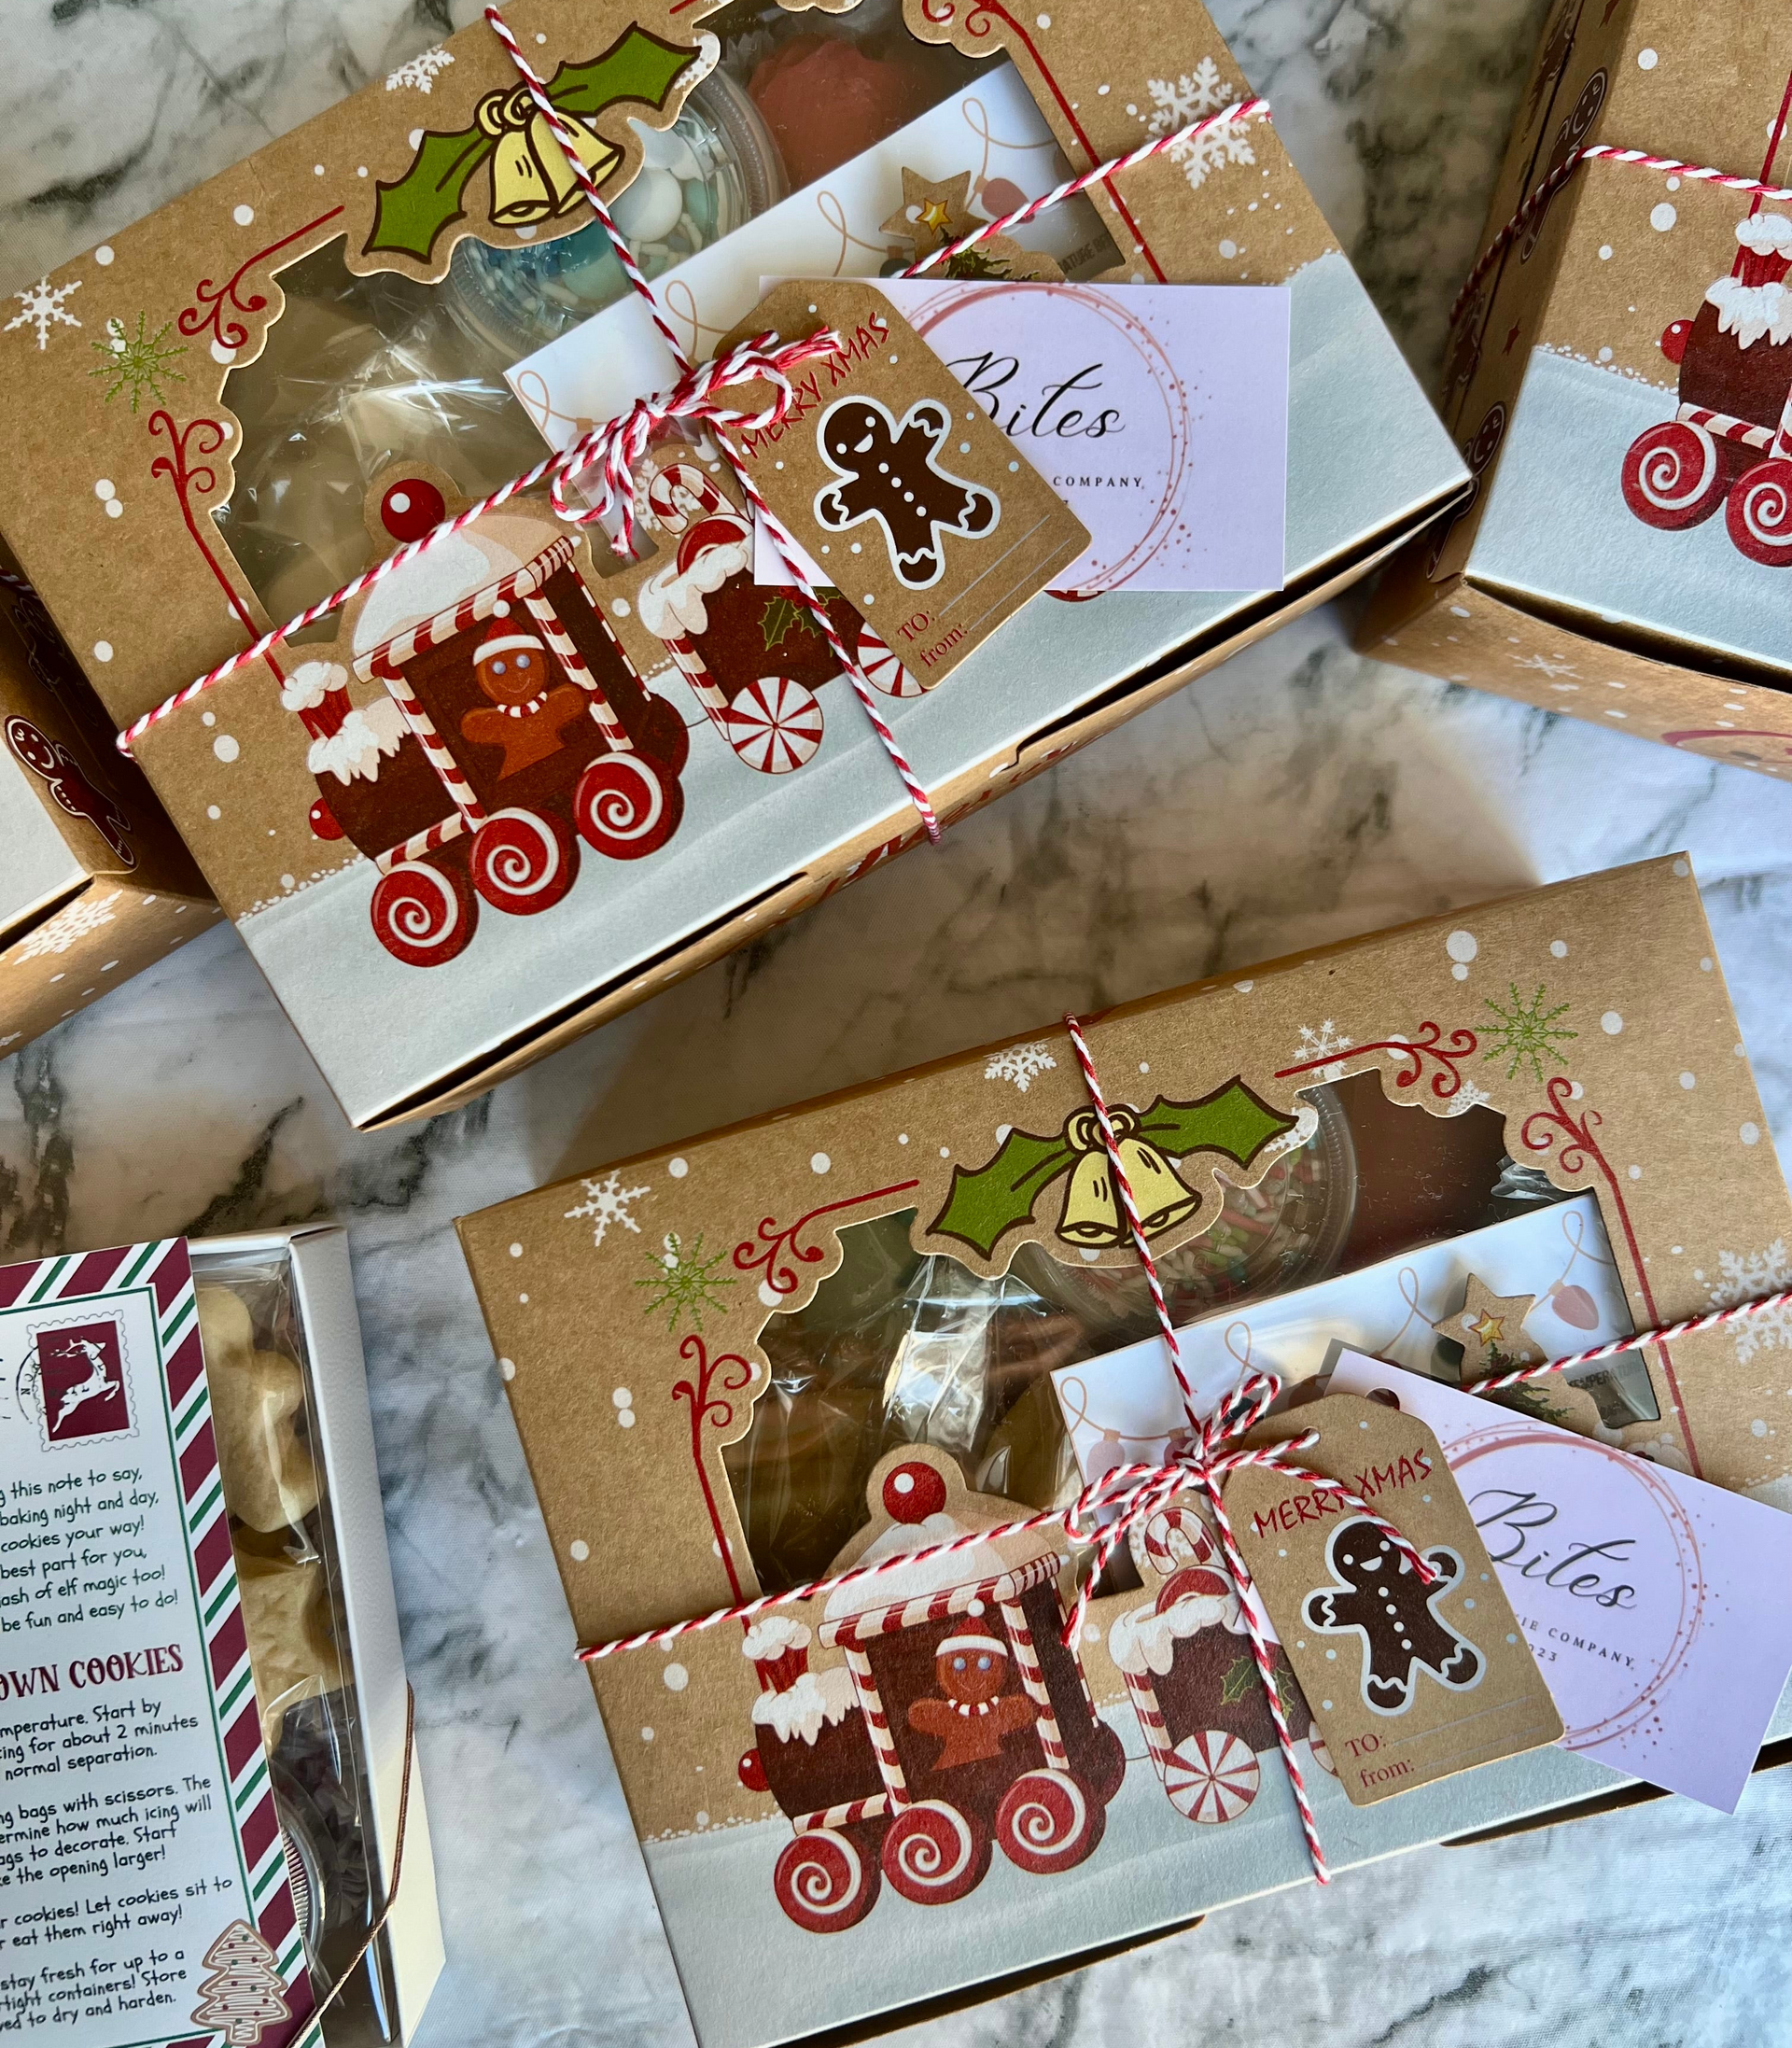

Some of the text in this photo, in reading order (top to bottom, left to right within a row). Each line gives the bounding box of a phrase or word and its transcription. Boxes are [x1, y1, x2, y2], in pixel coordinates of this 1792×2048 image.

[820, 311, 889, 387] XMAS
[945, 351, 1126, 438] Bites
[897, 610, 936, 642] TO:
[920, 623, 968, 667] from:
[10, 1480, 43, 1500] this
[49, 1473, 83, 1494] note
[88, 1469, 106, 1486] to
[112, 1468, 143, 1484] say,
[1354, 1447, 1433, 1500] XMAS
[0, 1488, 160, 1527] baking night and day,
[1, 1514, 145, 1552] cookies your way!
[1468, 1490, 1637, 1608] Bites
[0, 1548, 147, 1579] best part for you,
[0, 1564, 165, 1607] ash of elf magic too!
[1, 1588, 178, 1633] be fun and easy to do!
[68, 1643, 184, 1689] COOKIES
[92, 1700, 135, 1723] Start
[142, 1698, 161, 1718] by
[0, 1715, 199, 1763] ing for about 2 minutes
[1344, 1733, 1386, 1757] TO:
[5, 1744, 158, 1781] normal separation.
[1360, 1760, 1414, 1788] from:
[18, 1804, 57, 1827] bags
[63, 1792, 98, 1813] with
[105, 1784, 178, 1806] scissors.
[182, 1774, 211, 1792] The
[56, 1818, 89, 1835] how
[96, 1806, 138, 1829] much
[145, 1804, 180, 1822] icing
[185, 1793, 212, 1815] will
[29, 1845, 48, 1861] to
[54, 1831, 130, 1857] decorate.
[133, 1821, 177, 1843] Start
[17, 1866, 44, 1885] the
[49, 1859, 109, 1883] opening
[113, 1845, 166, 1871] larger!
[14, 1901, 79, 1926] cookies!
[86, 1895, 112, 1915] Let
[118, 1887, 179, 1908] cookies
[186, 1878, 207, 1897] sit
[213, 1875, 232, 1894] to
[12, 1929, 39, 1947] eat
[45, 1924, 87, 1943] them
[92, 1915, 132, 1939] right
[137, 1903, 183, 1926] away!
[0, 1949, 185, 1991] stay fresh for up to a
[48, 1973, 136, 2002] containers!
[141, 1968, 188, 1987] Store
[26, 2010, 47, 2027] to
[52, 2006, 78, 2025] dry
[85, 1999, 113, 2017] and
[118, 1990, 176, 2011] harden.
